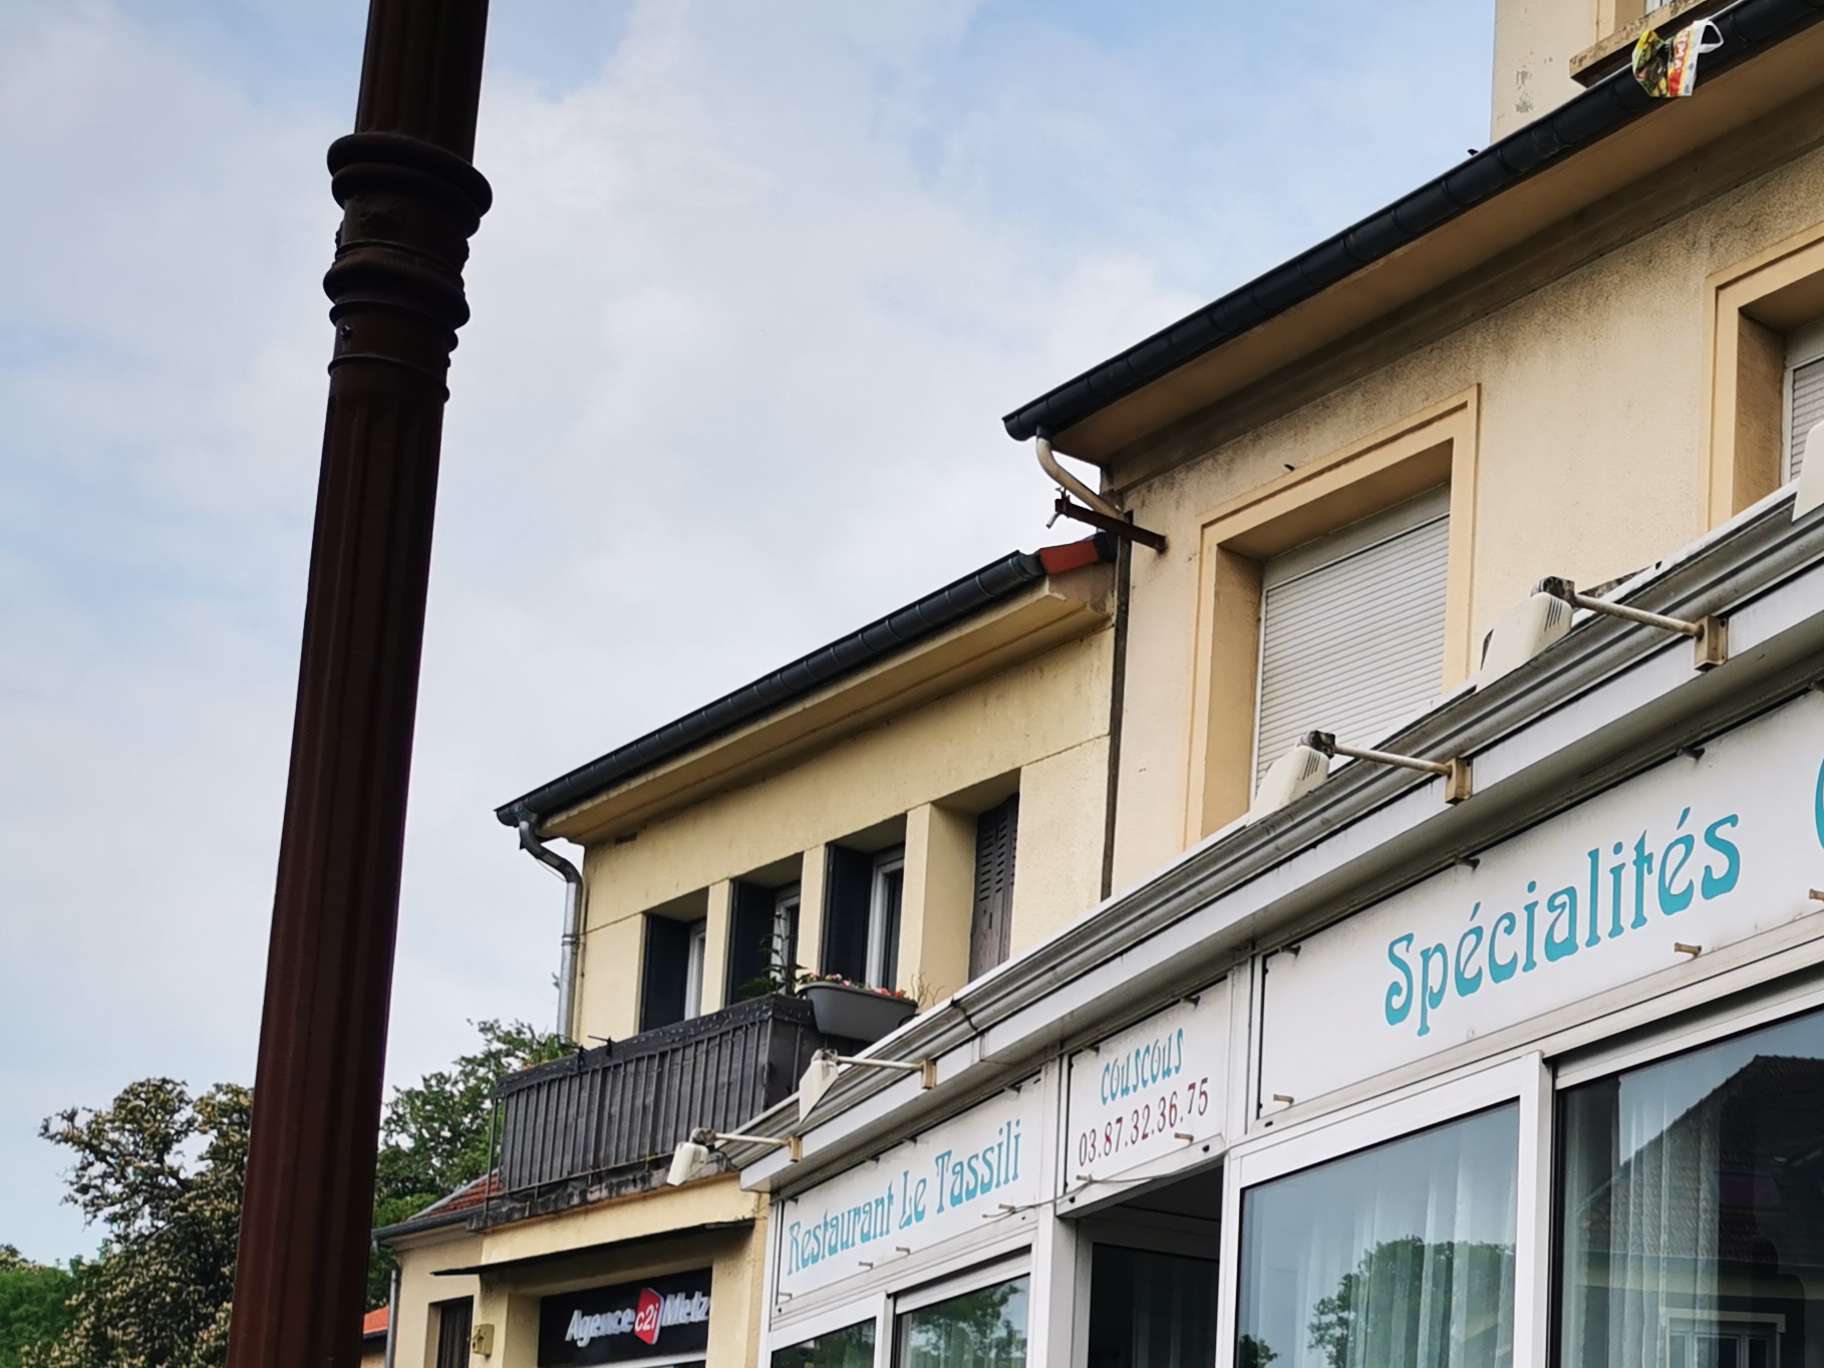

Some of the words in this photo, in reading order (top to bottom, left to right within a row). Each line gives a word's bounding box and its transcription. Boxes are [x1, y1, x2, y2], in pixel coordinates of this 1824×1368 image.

[1385, 806, 1741, 1036] Spécialités
[1079, 1077, 1208, 1167] 03.87.32.36.75
[787, 1180, 894, 1276] Restaurant
[899, 1170, 927, 1230] Le
[935, 1119, 1022, 1214] Tassili
[565, 1308, 635, 1347] Agence
[661, 1291, 711, 1326] Metz
